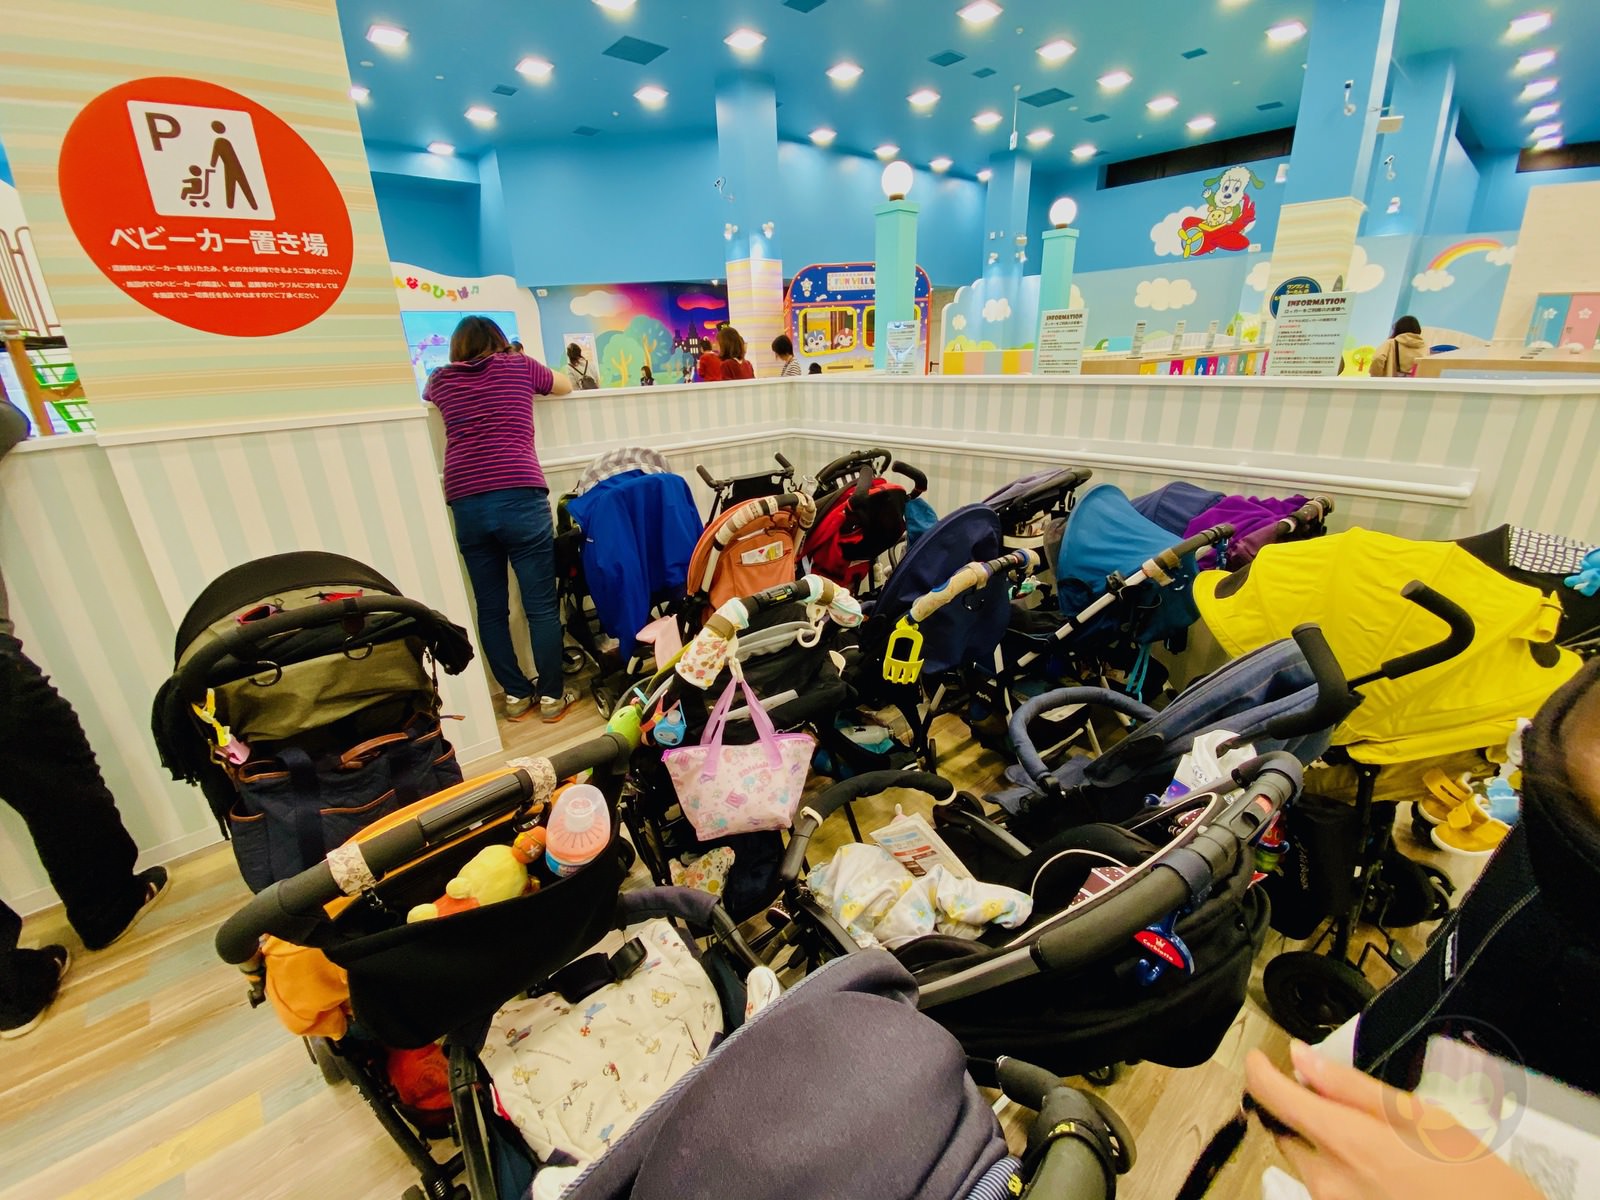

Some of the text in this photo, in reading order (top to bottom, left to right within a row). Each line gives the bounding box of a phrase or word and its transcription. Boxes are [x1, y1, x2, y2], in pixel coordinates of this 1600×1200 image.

[145, 112, 181, 151] P
[109, 226, 329, 257] ベビーカー置き場
[1287, 298, 1346, 307] INFORMATION
